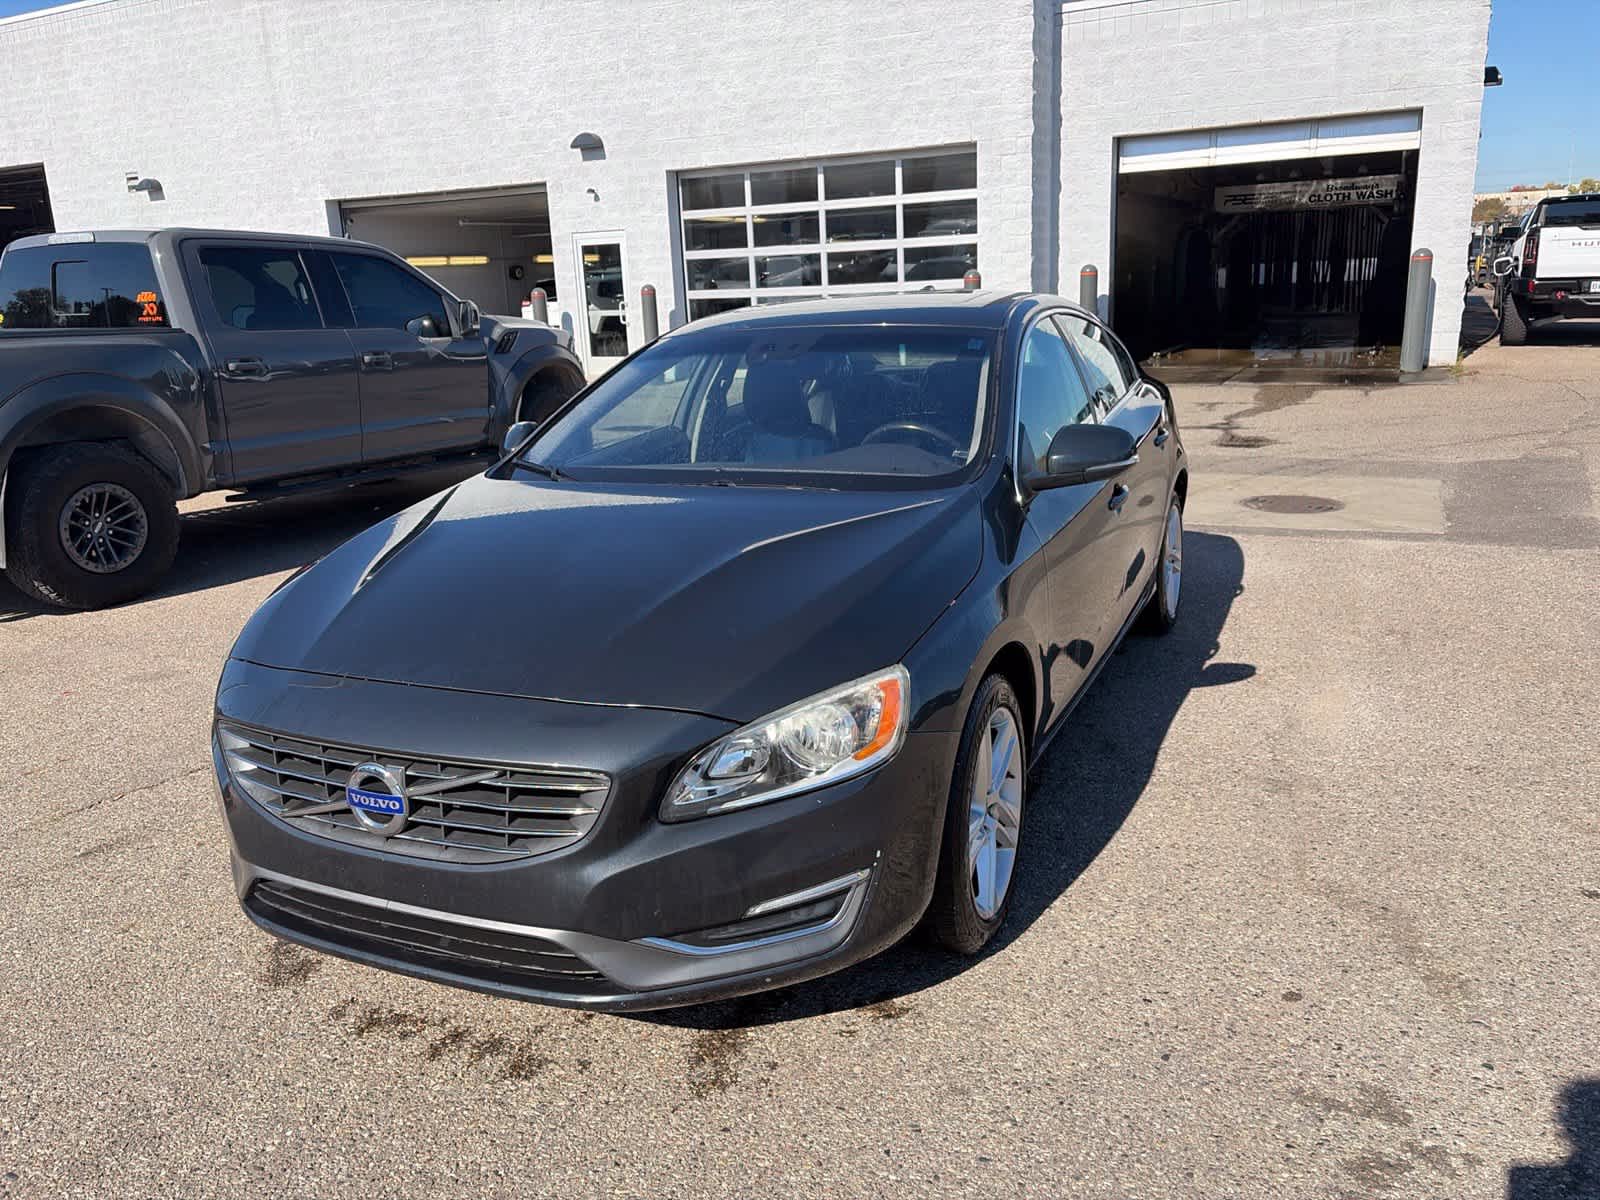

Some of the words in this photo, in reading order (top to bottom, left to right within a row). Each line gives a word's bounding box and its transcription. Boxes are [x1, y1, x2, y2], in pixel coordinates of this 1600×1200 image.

[1308, 191, 1352, 203] CLOTH
[1355, 188, 1394, 200] WASH
[349, 792, 401, 810] VOLVO
